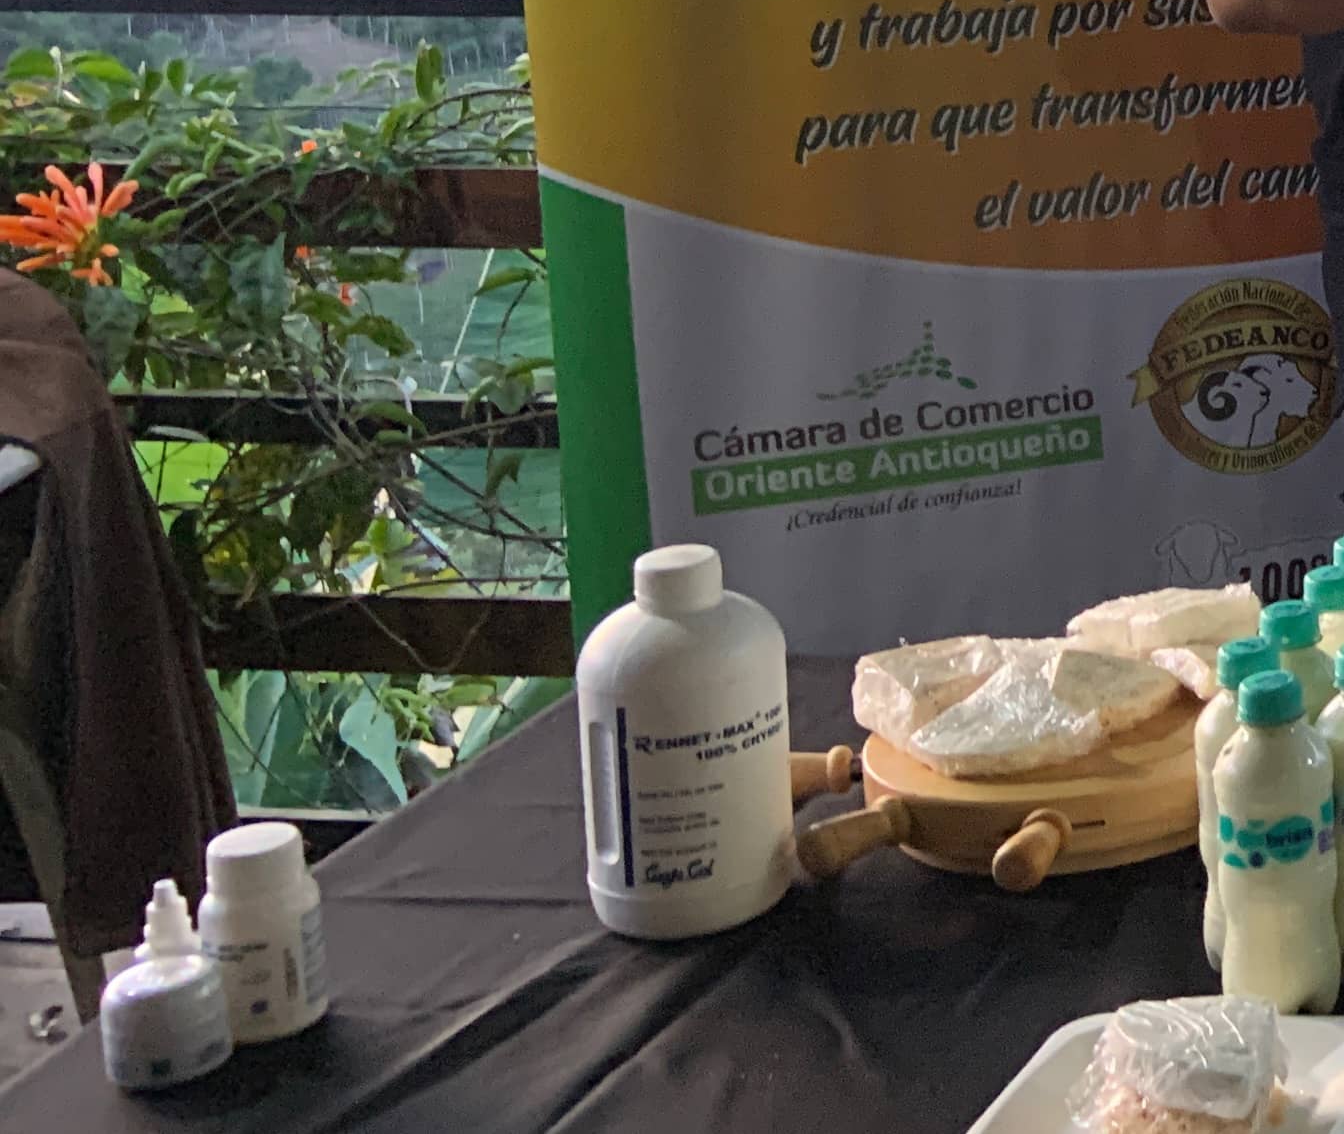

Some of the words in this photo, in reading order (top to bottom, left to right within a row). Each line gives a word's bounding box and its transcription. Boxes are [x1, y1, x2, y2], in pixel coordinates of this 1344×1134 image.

[810, 22, 845, 67] y
[794, 114, 918, 165] para
[931, 99, 1015, 153] que
[974, 180, 1021, 231] el
[1028, 172, 1151, 224] valor
[1161, 160, 1230, 210] del
[1239, 161, 1321, 204] cam
[1167, 324, 1329, 371] FEDEANCO
[694, 417, 847, 463] Cámara
[859, 407, 904, 440] de
[916, 384, 1095, 435] Comercio
[704, 461, 856, 503] Oriente
[868, 424, 1091, 480] Antioqueño
[897, 494, 920, 515] de
[923, 477, 1023, 514] confianza!
